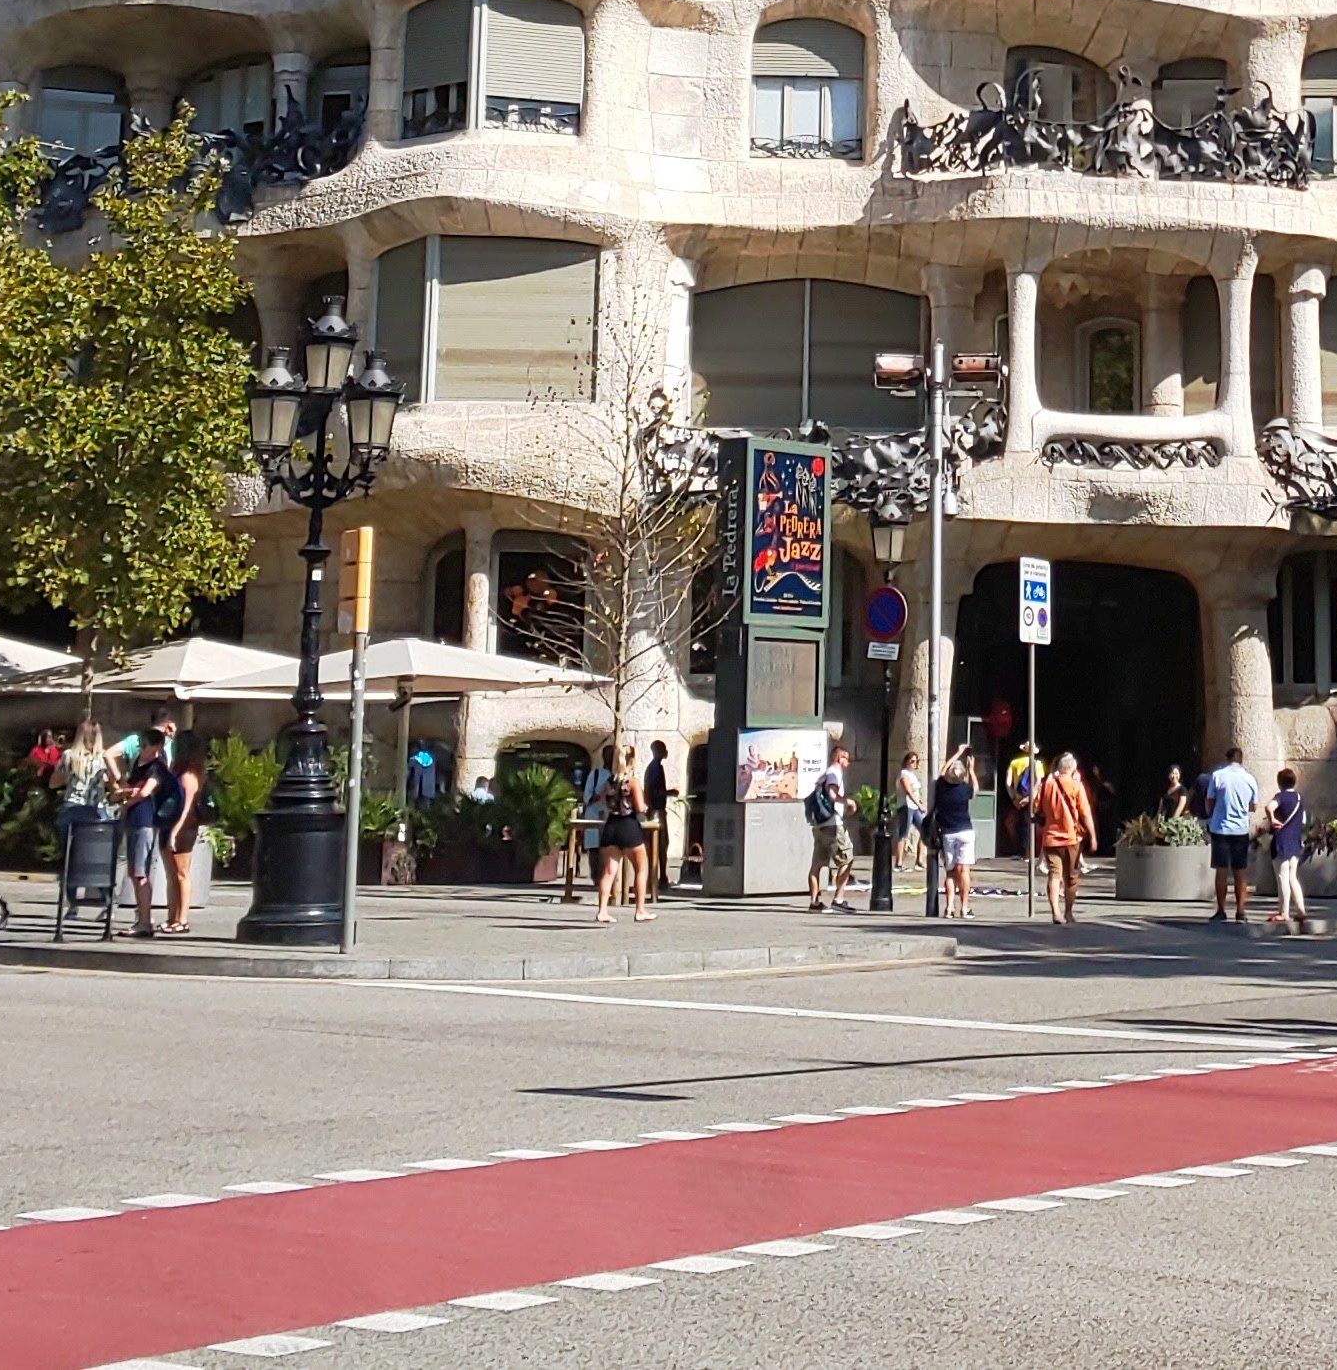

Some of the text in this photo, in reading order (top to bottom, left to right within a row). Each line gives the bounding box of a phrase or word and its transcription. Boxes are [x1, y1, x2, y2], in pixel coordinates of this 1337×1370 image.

[783, 500, 798, 515] La
[779, 514, 822, 540] PEDRERA
[721, 485, 740, 599] La Pedrera
[778, 536, 822, 563] Jazz
